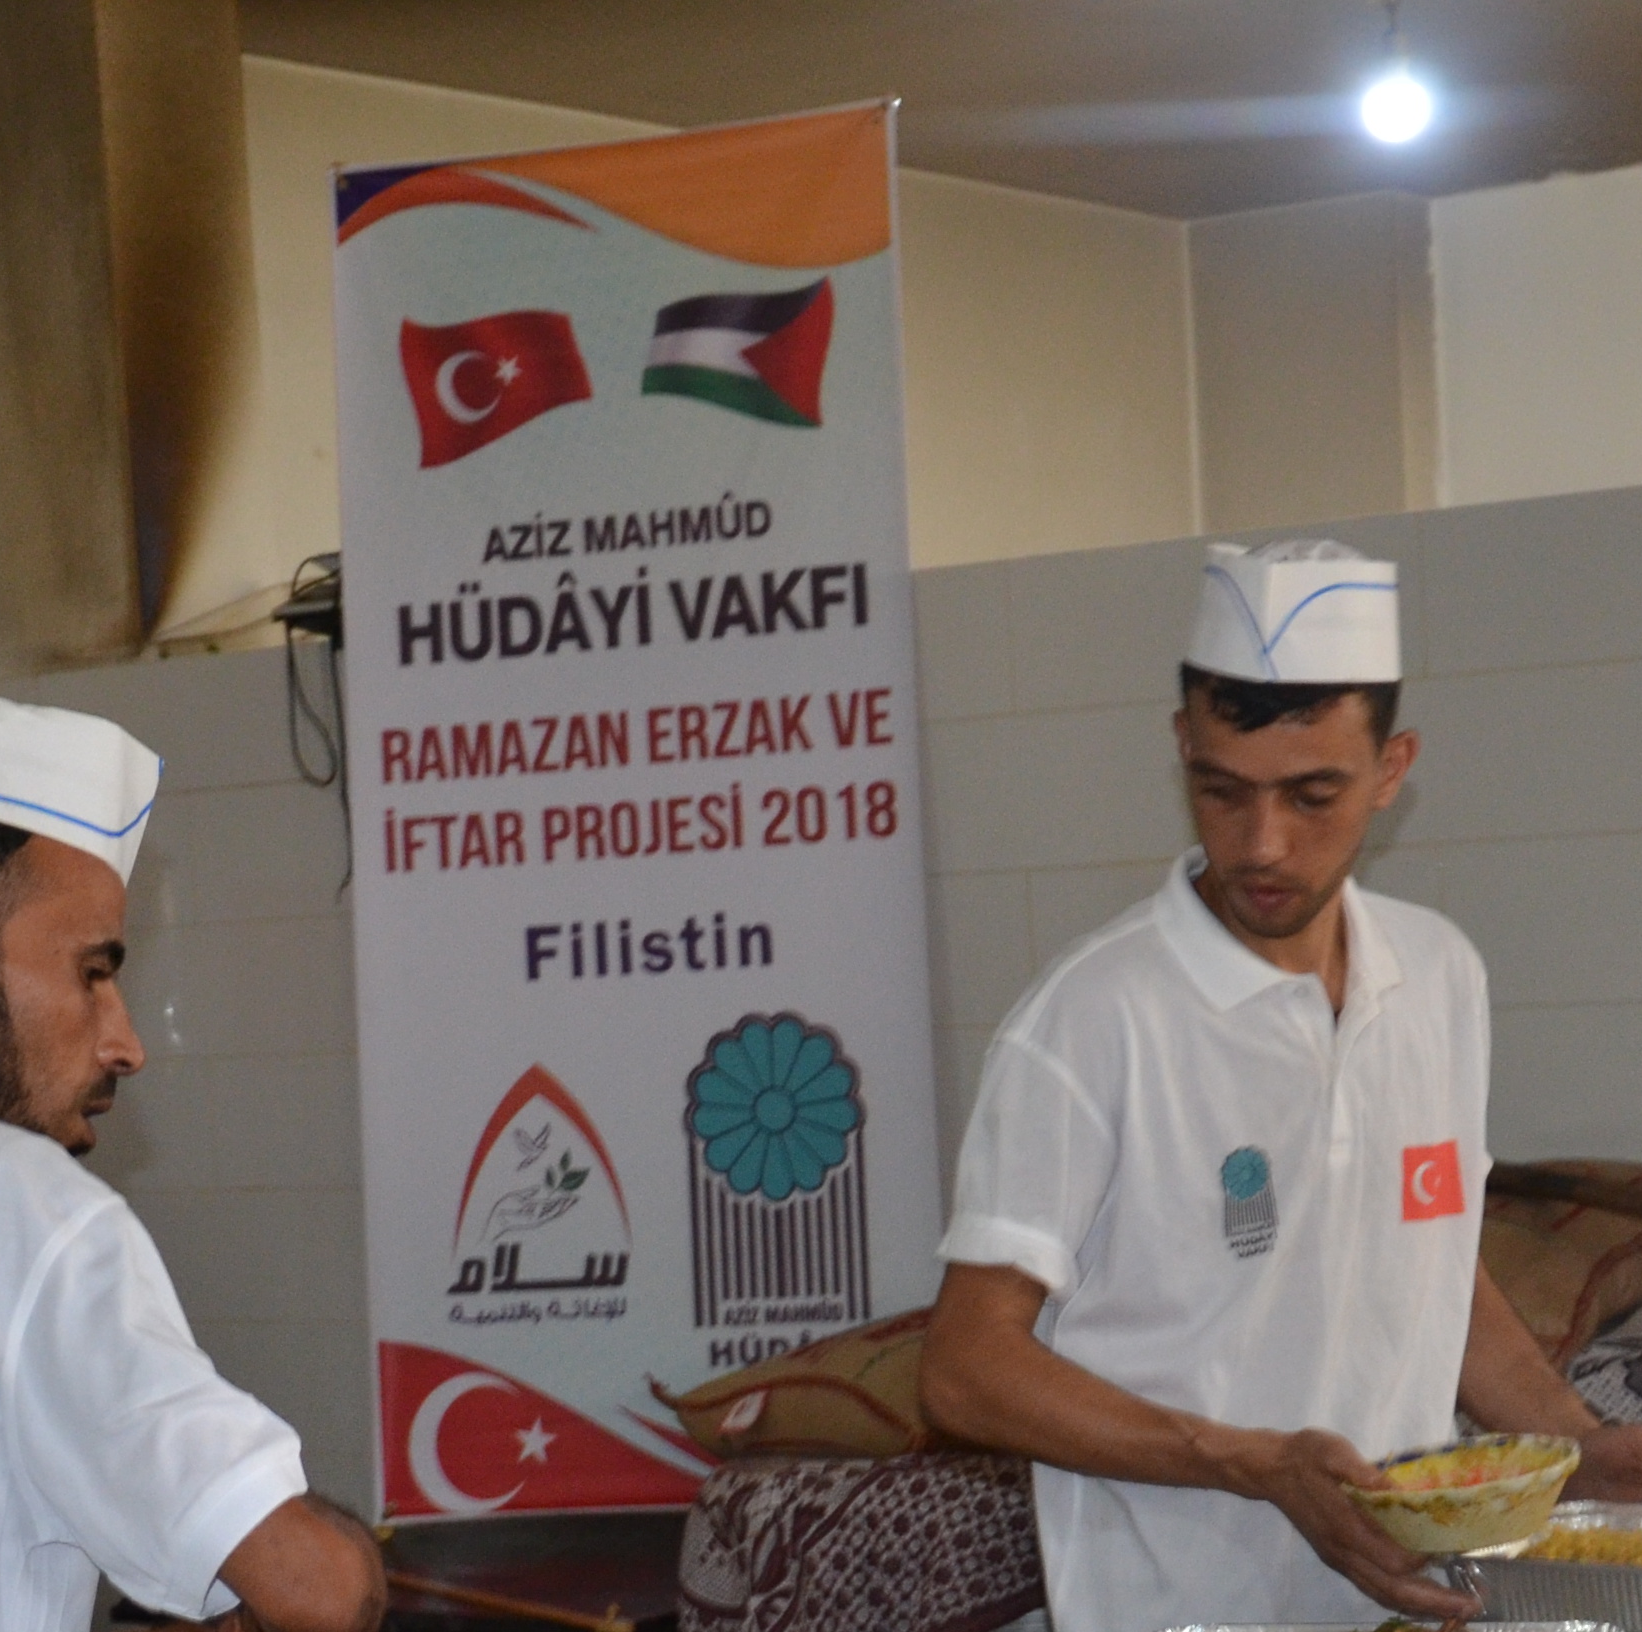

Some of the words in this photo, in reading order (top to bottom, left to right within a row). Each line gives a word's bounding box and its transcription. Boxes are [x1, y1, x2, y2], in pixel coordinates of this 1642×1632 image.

[482, 511, 571, 564] AZİZ
[397, 565, 653, 666] HÜDÂYİ
[669, 562, 870, 643] VAKFI
[381, 709, 630, 785] RAMAZAN
[647, 694, 813, 765] ERZAK
[825, 686, 895, 748] VE
[382, 808, 525, 874] İFTAR
[542, 781, 745, 862] PROJESİ
[761, 779, 899, 847] 2018
[524, 913, 775, 981] Filistin
